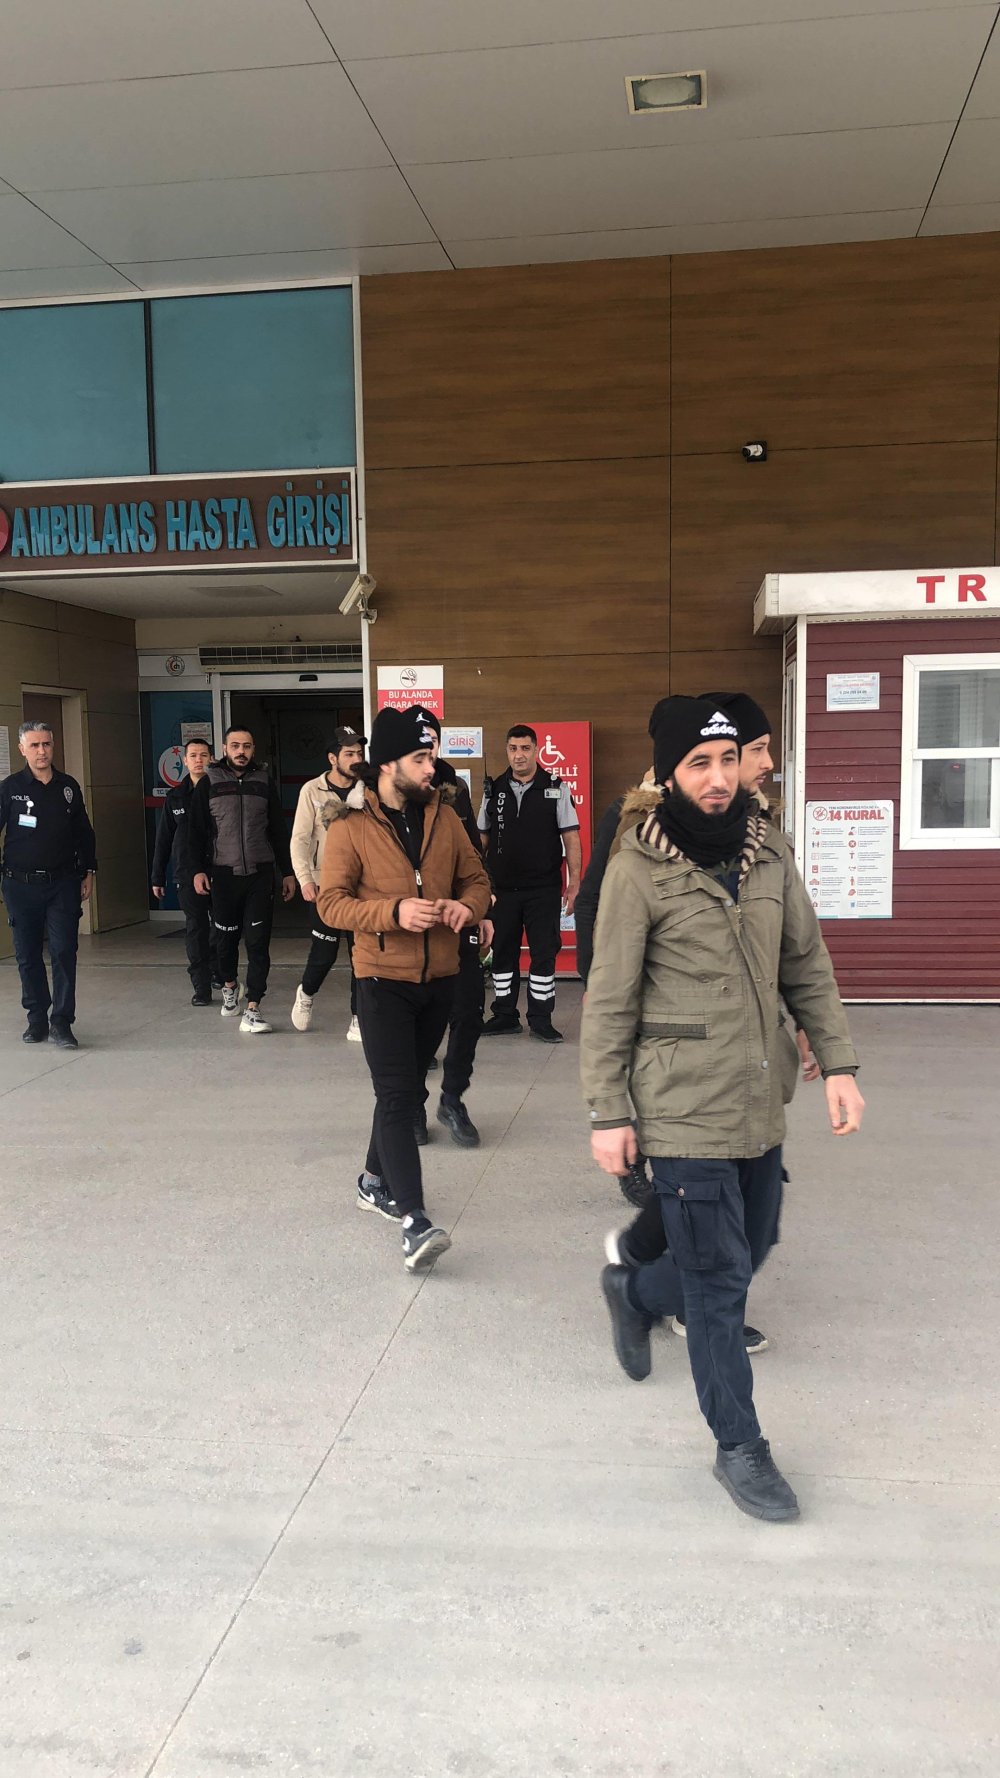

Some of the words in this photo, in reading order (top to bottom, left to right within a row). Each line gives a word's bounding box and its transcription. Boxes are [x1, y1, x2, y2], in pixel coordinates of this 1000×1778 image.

[11, 500, 157, 557] AMBULANS
[165, 498, 258, 551] HASTA
[266, 479, 350, 554] GİRİŞİ
[388, 691, 400, 699] BU
[401, 690, 433, 698] ALANDA
[383, 700, 412, 708] SİGARA
[700, 723, 738, 736] adidas
[448, 736, 475, 747] GİRİŞ
[828, 810, 842, 820] 14
[844, 809, 884, 820] KURAL
